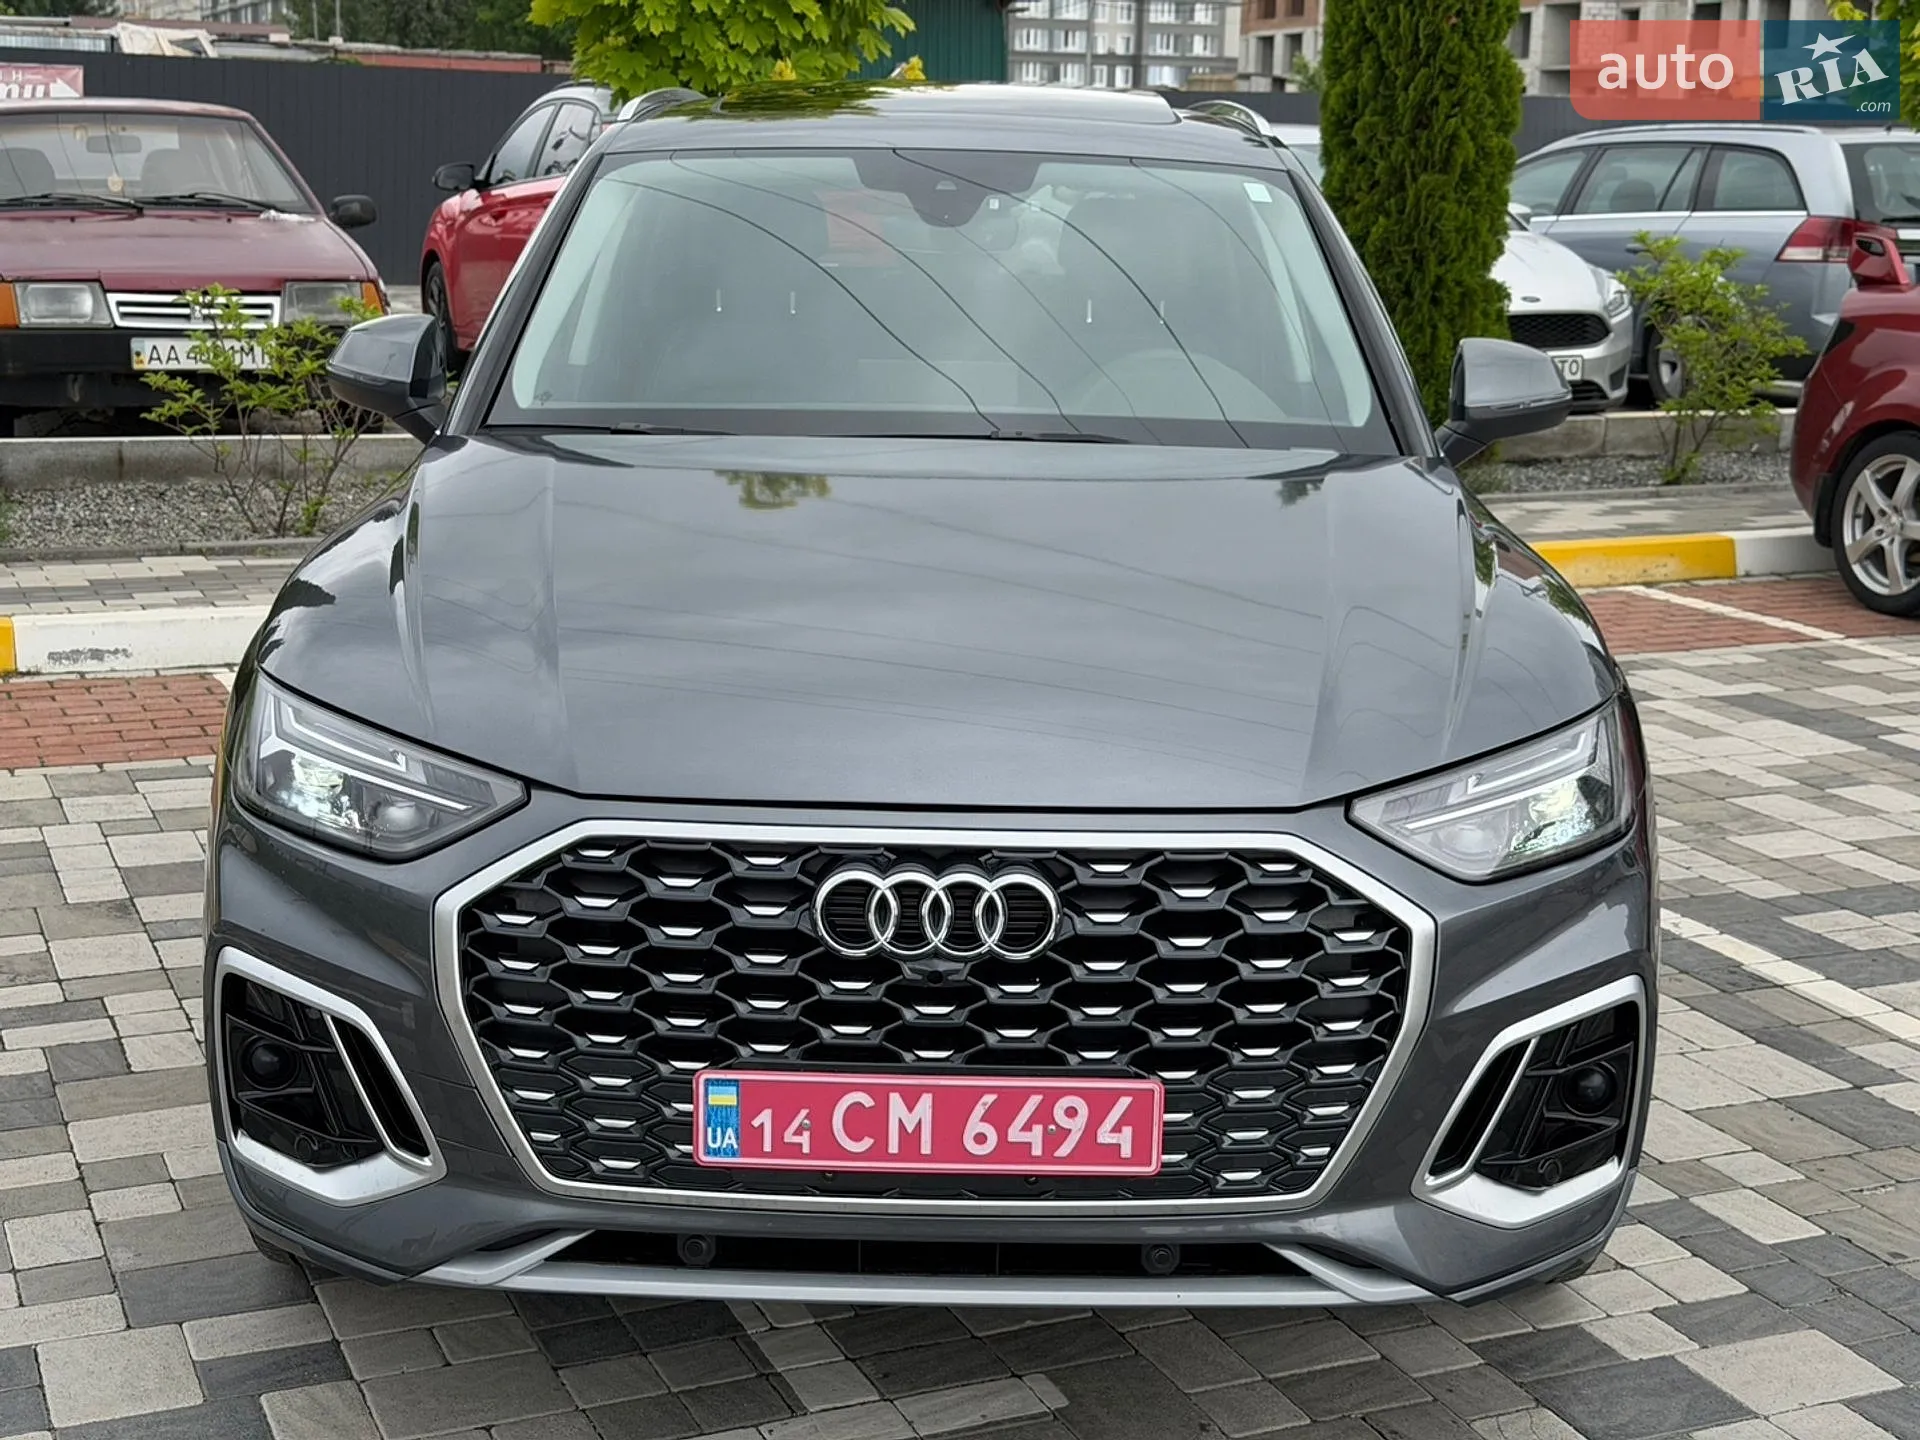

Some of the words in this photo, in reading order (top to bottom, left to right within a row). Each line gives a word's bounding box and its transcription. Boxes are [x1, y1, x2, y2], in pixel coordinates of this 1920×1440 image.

[148, 344, 180, 365] AA
[750, 1107, 811, 1154] 14
[832, 1090, 932, 1156] CM
[963, 1093, 1133, 1159] 6494
[706, 1128, 739, 1150] UA
